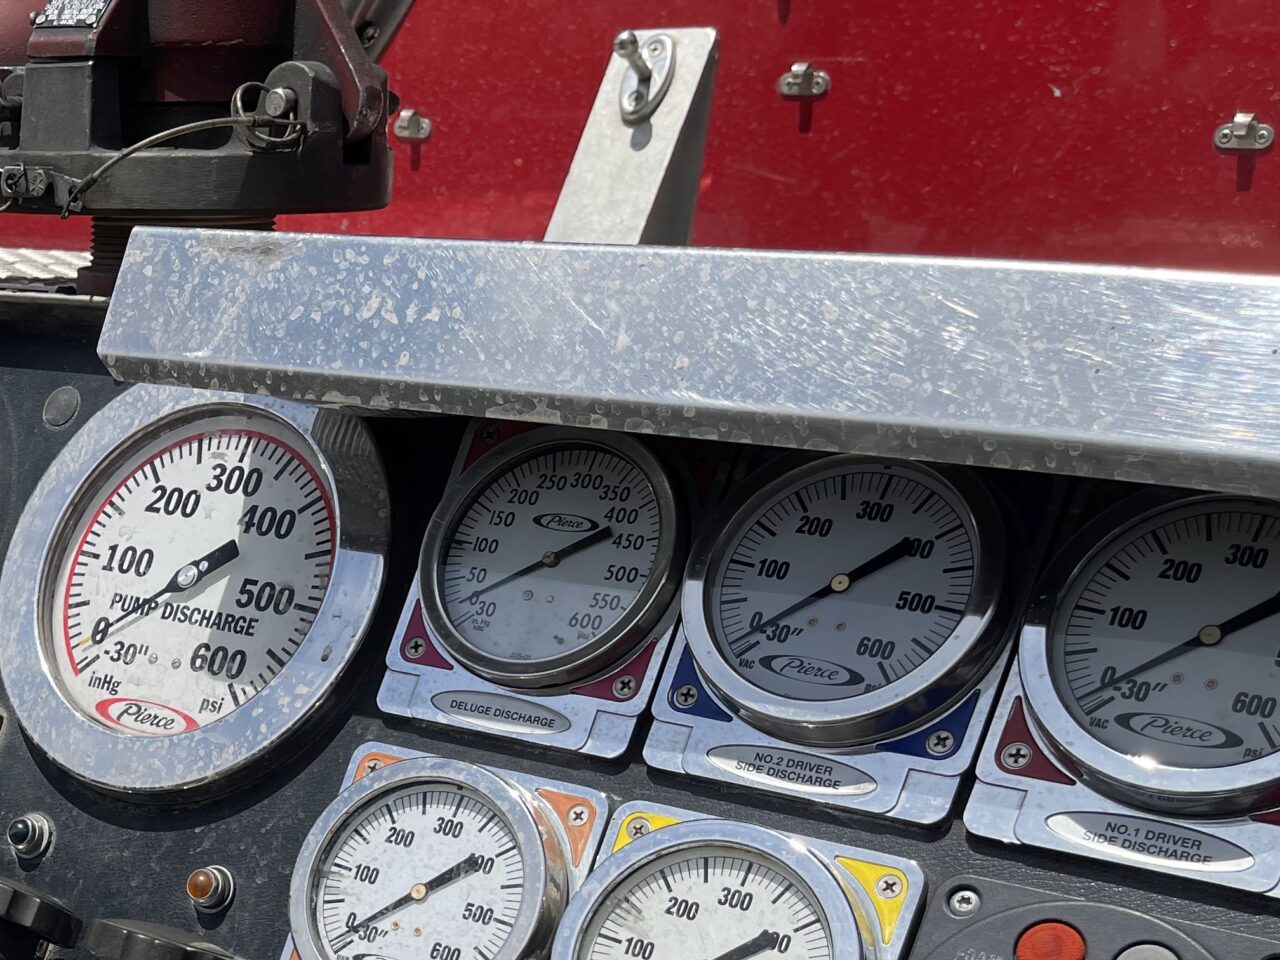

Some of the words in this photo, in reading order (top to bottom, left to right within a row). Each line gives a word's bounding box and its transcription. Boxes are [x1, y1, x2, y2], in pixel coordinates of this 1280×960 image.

[205, 463, 263, 497] 300
[537, 473, 567, 491] 250
[570, 473, 603, 490] 300
[145, 485, 201, 519] 200
[507, 489, 539, 506] 200
[599, 485, 630, 501] 350
[238, 504, 296, 540] 400
[489, 510, 515, 527] 150
[547, 516, 584, 530] Pierce
[604, 507, 639, 525] 400
[855, 501, 894, 523] 300
[795, 516, 833, 538] 200
[473, 537, 499, 554] 100
[611, 533, 644, 550] 450
[102, 543, 154, 577] 100
[1224, 543, 1269, 569] 300
[467, 567, 487, 583] 50
[603, 565, 639, 583] 500
[758, 558, 791, 581] 100
[1158, 558, 1202, 584] 200
[235, 578, 295, 616] 500
[589, 592, 620, 611] 550
[895, 590, 936, 614] 500
[110, 592, 159, 616] PUMP
[161, 607, 260, 637] DISCHARGE
[568, 612, 603, 630] 600
[1109, 605, 1147, 630] 100
[856, 636, 896, 660] 600
[189, 642, 247, 680] 600
[738, 657, 755, 670] VAC
[780, 658, 840, 681] Pierce
[88, 671, 122, 695] inHg
[120, 701, 176, 730] Pierce
[199, 697, 225, 714] psi
[450, 699, 492, 717] DELUGE
[494, 708, 556, 728] DISCHARGE
[1231, 691, 1277, 718] 600
[1088, 716, 1109, 730] VAC
[1141, 715, 1213, 742] Pierce
[753, 751, 784, 767] NO.2
[786, 756, 833, 777] DRIVER
[1243, 746, 1264, 759] psi
[734, 760, 766, 777] SIDE
[768, 765, 842, 791] DISCHARGE
[385, 827, 415, 848] 200
[433, 817, 464, 838] 300
[1105, 821, 1141, 838] NO.1
[1144, 829, 1202, 851] DRIVER
[1082, 830, 1118, 846] SIDE
[1121, 836, 1213, 866] DISCHARGE
[353, 863, 380, 885] 100
[665, 897, 700, 921] 200
[717, 888, 753, 911] 300
[462, 903, 494, 925] 500
[623, 937, 655, 960] 100
